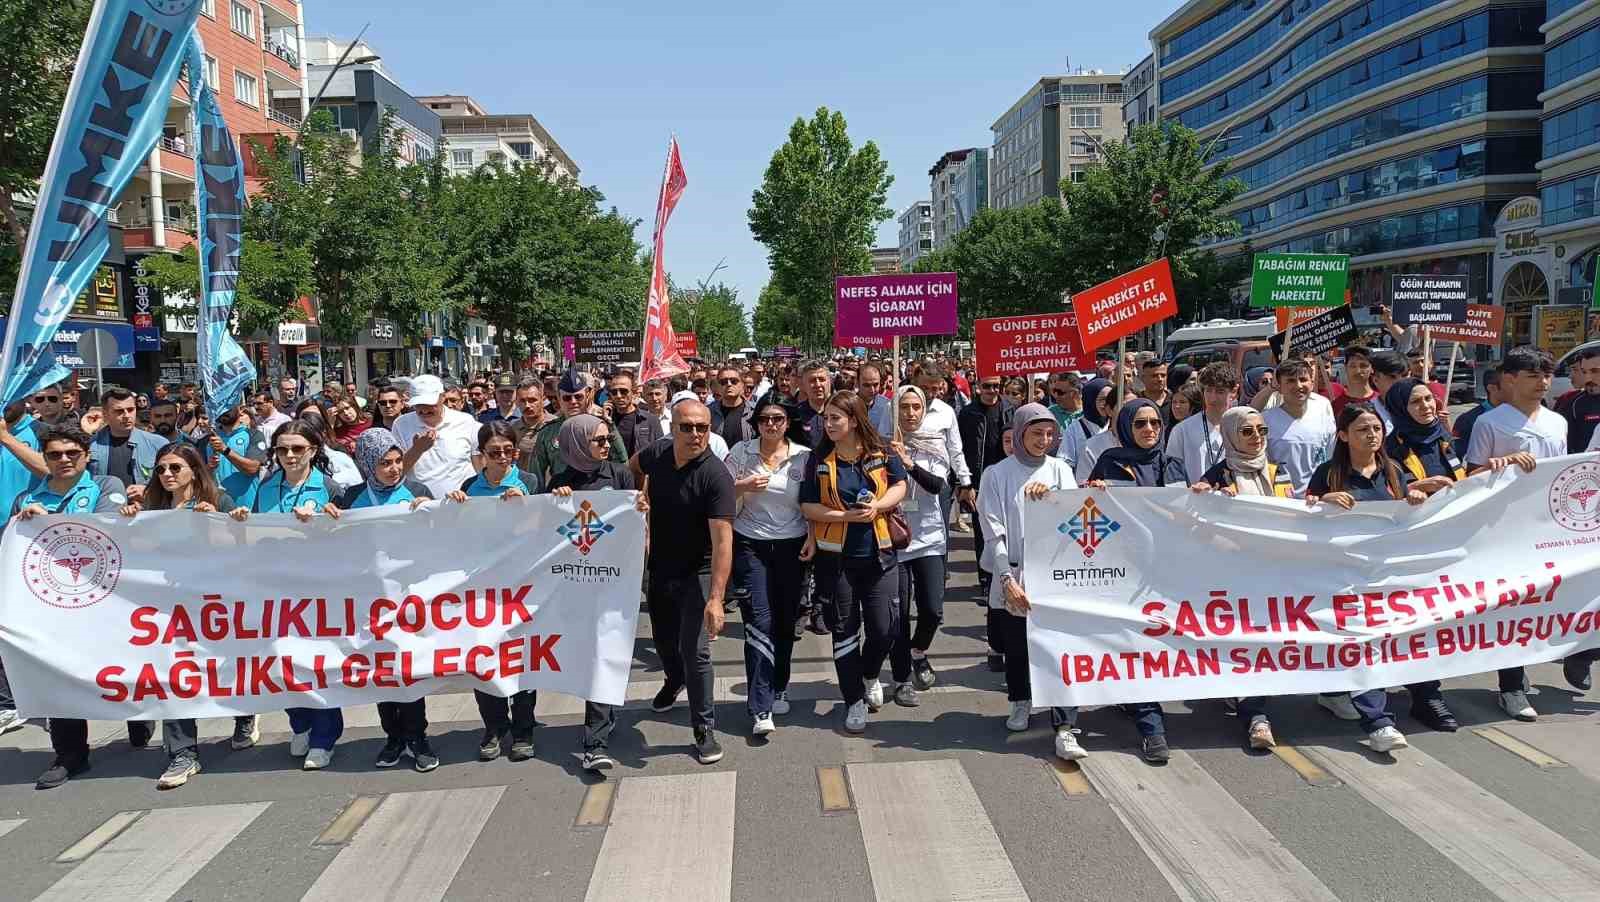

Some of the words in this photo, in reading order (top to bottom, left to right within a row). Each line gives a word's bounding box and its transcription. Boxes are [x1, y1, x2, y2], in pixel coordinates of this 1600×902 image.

[1259, 257, 1306, 271] TABAĞIM
[1308, 258, 1346, 271] RENKLİ
[1277, 275, 1323, 286] HAYATIM
[1400, 278, 1422, 288] ÖĞÜN
[1424, 280, 1461, 289] ATLAMAYIN
[841, 286, 878, 298] NEFES
[880, 284, 924, 297] ALMAK
[927, 281, 953, 298] İÇİN
[1091, 284, 1141, 315] HAREKET
[1142, 278, 1156, 291] ET
[1271, 287, 1326, 301] HAREKETLİ
[1394, 291, 1428, 299] KAHVALTI
[1429, 291, 1466, 299] YAPMADAN
[869, 298, 925, 313] SİGARAYI
[1421, 300, 1440, 310] GÜNE
[1087, 304, 1137, 335] SAĞLIKLI
[1138, 291, 1168, 312] YAŞA
[1409, 313, 1452, 323] BAŞLAMAYIN
[872, 315, 923, 328] BIRAKIN
[992, 317, 1037, 332] GÜNDE
[1041, 319, 1057, 329] EN
[1061, 317, 1078, 328] AZ
[1015, 335, 1022, 344] 2
[1026, 333, 1056, 343] DEFA
[1459, 327, 1497, 339] BAĞLAN
[1000, 342, 1071, 359] DİŞLERİNİZİ
[995, 357, 1077, 373] FIRÇALAYINIZ
[551, 564, 620, 577] BATMAN
[1053, 567, 1126, 581] BATMAN
[1142, 590, 1321, 637] SAĞLIK
[1332, 561, 1562, 631] FESTİVALİ
[128, 594, 356, 646] SAĞLIKLI
[369, 584, 533, 641] ÇOCUK
[1062, 647, 1221, 687] (BATMAN
[1230, 637, 1379, 674] SAĞLIĞI
[1381, 632, 1429, 664] İLE
[96, 650, 328, 702] SAĞLIKLI
[341, 634, 562, 688] GELECEK
